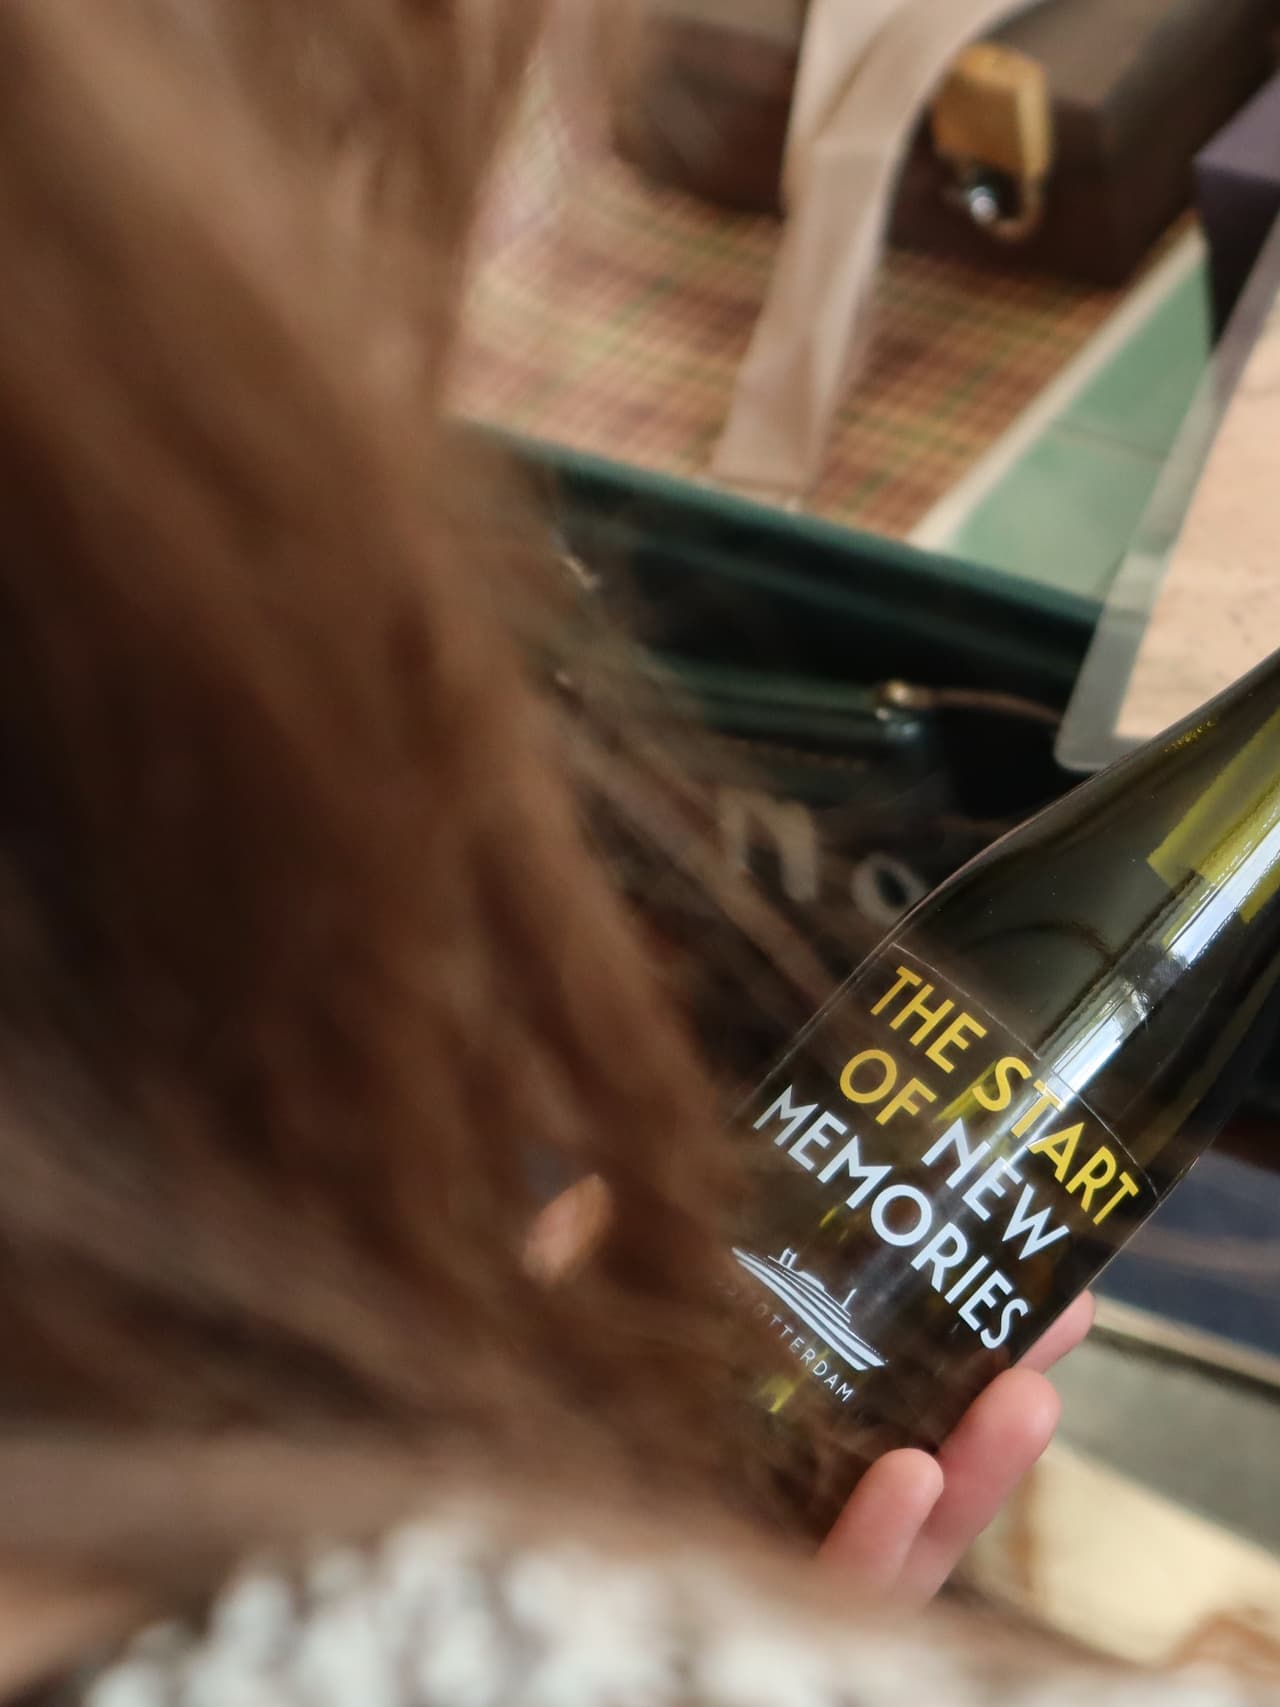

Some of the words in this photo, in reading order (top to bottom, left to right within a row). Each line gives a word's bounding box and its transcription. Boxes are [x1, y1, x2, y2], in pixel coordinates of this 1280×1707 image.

[839, 1049, 937, 1125] OF
[920, 1116, 1069, 1260] NEW
[871, 966, 987, 1073] THE
[972, 1056, 1139, 1225] START
[753, 1084, 1029, 1349] MEMORIES
[752, 1302, 854, 1403] OTTERDAM
